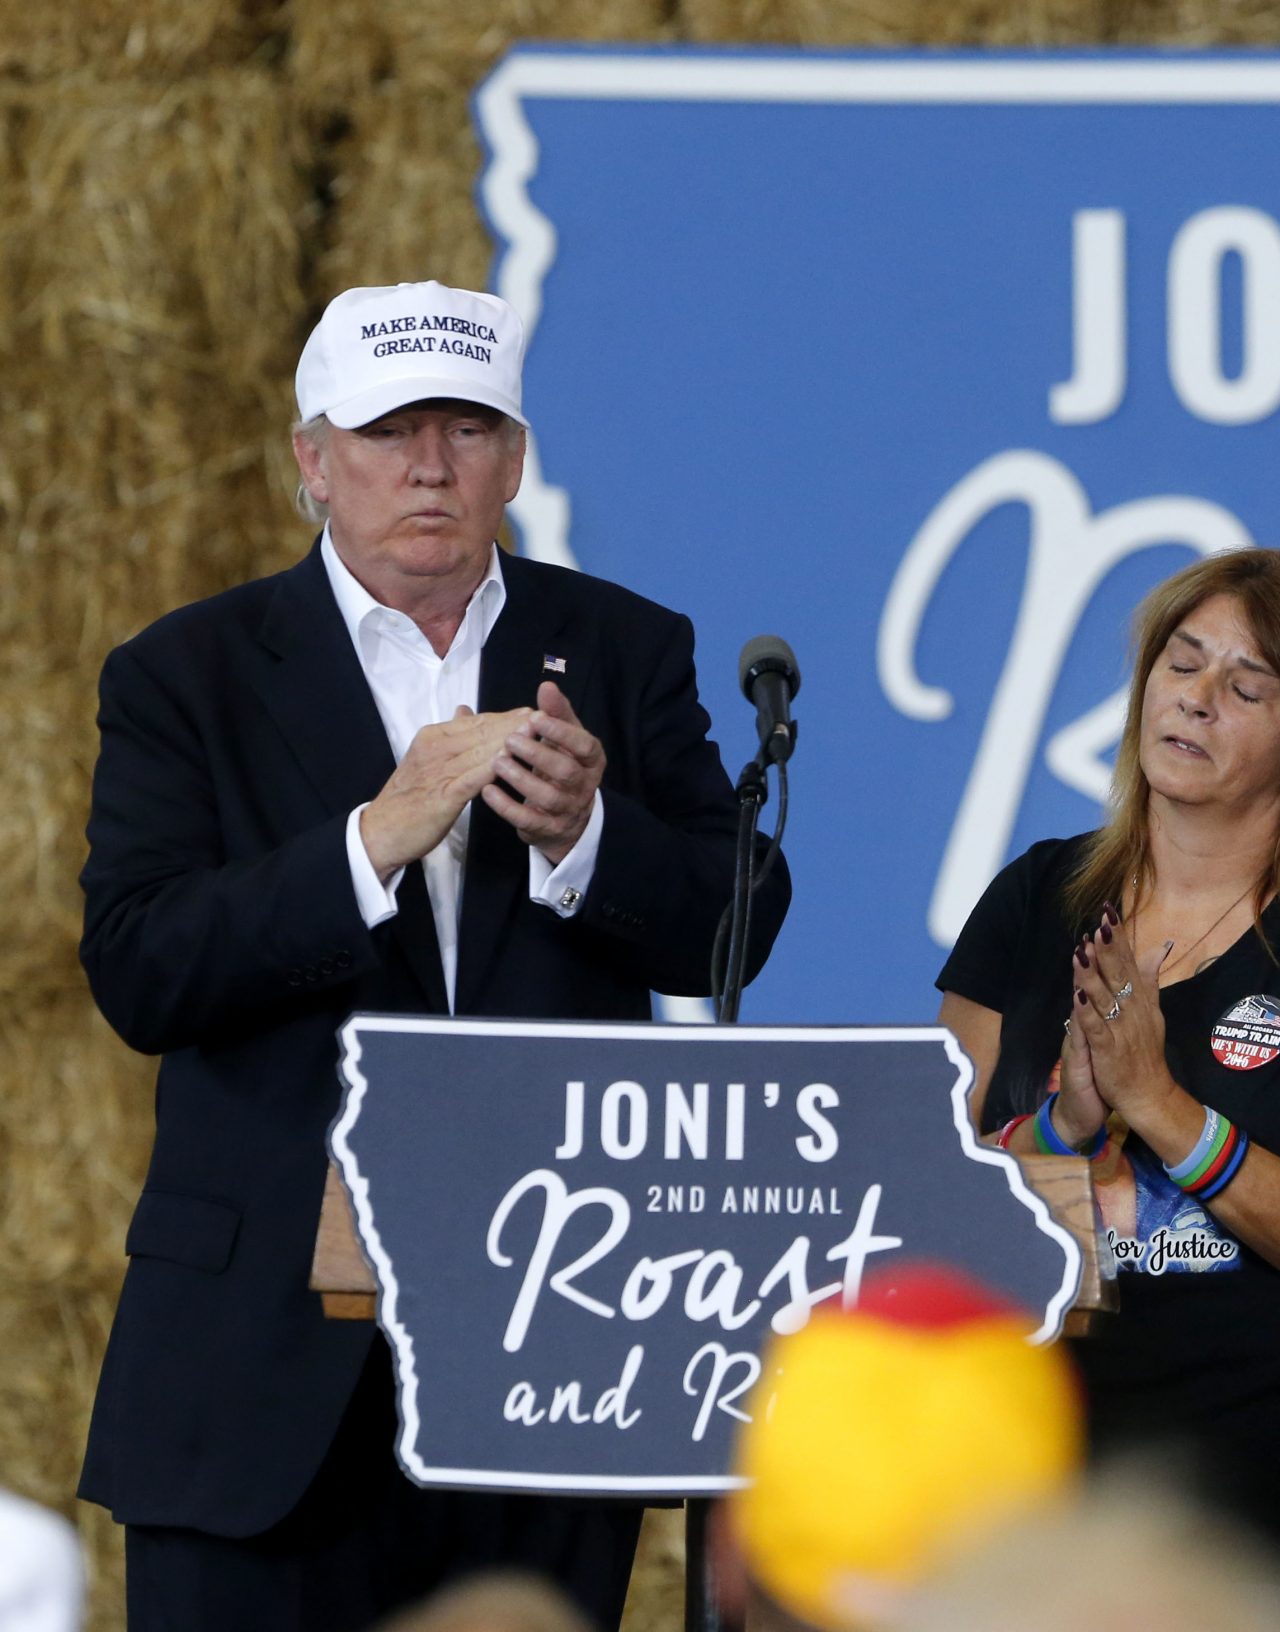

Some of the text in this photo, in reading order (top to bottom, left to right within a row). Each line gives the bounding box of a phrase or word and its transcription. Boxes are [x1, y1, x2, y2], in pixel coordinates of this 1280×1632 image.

[361, 315, 499, 344] MAKE AMERICA
[373, 337, 492, 364] GREAT AGAIN
[1213, 1038, 1271, 1059] HE'S WITH US
[1214, 1025, 1280, 1046] TRUMP TRAIN
[1222, 1052, 1250, 1068] 2016
[555, 1080, 840, 1163] JONI'S
[646, 1185, 843, 1214] 2ND ANNUAL
[486, 1168, 903, 1353] Roast
[1149, 1229, 1236, 1272] Justice
[504, 1341, 780, 1442] and Ri
